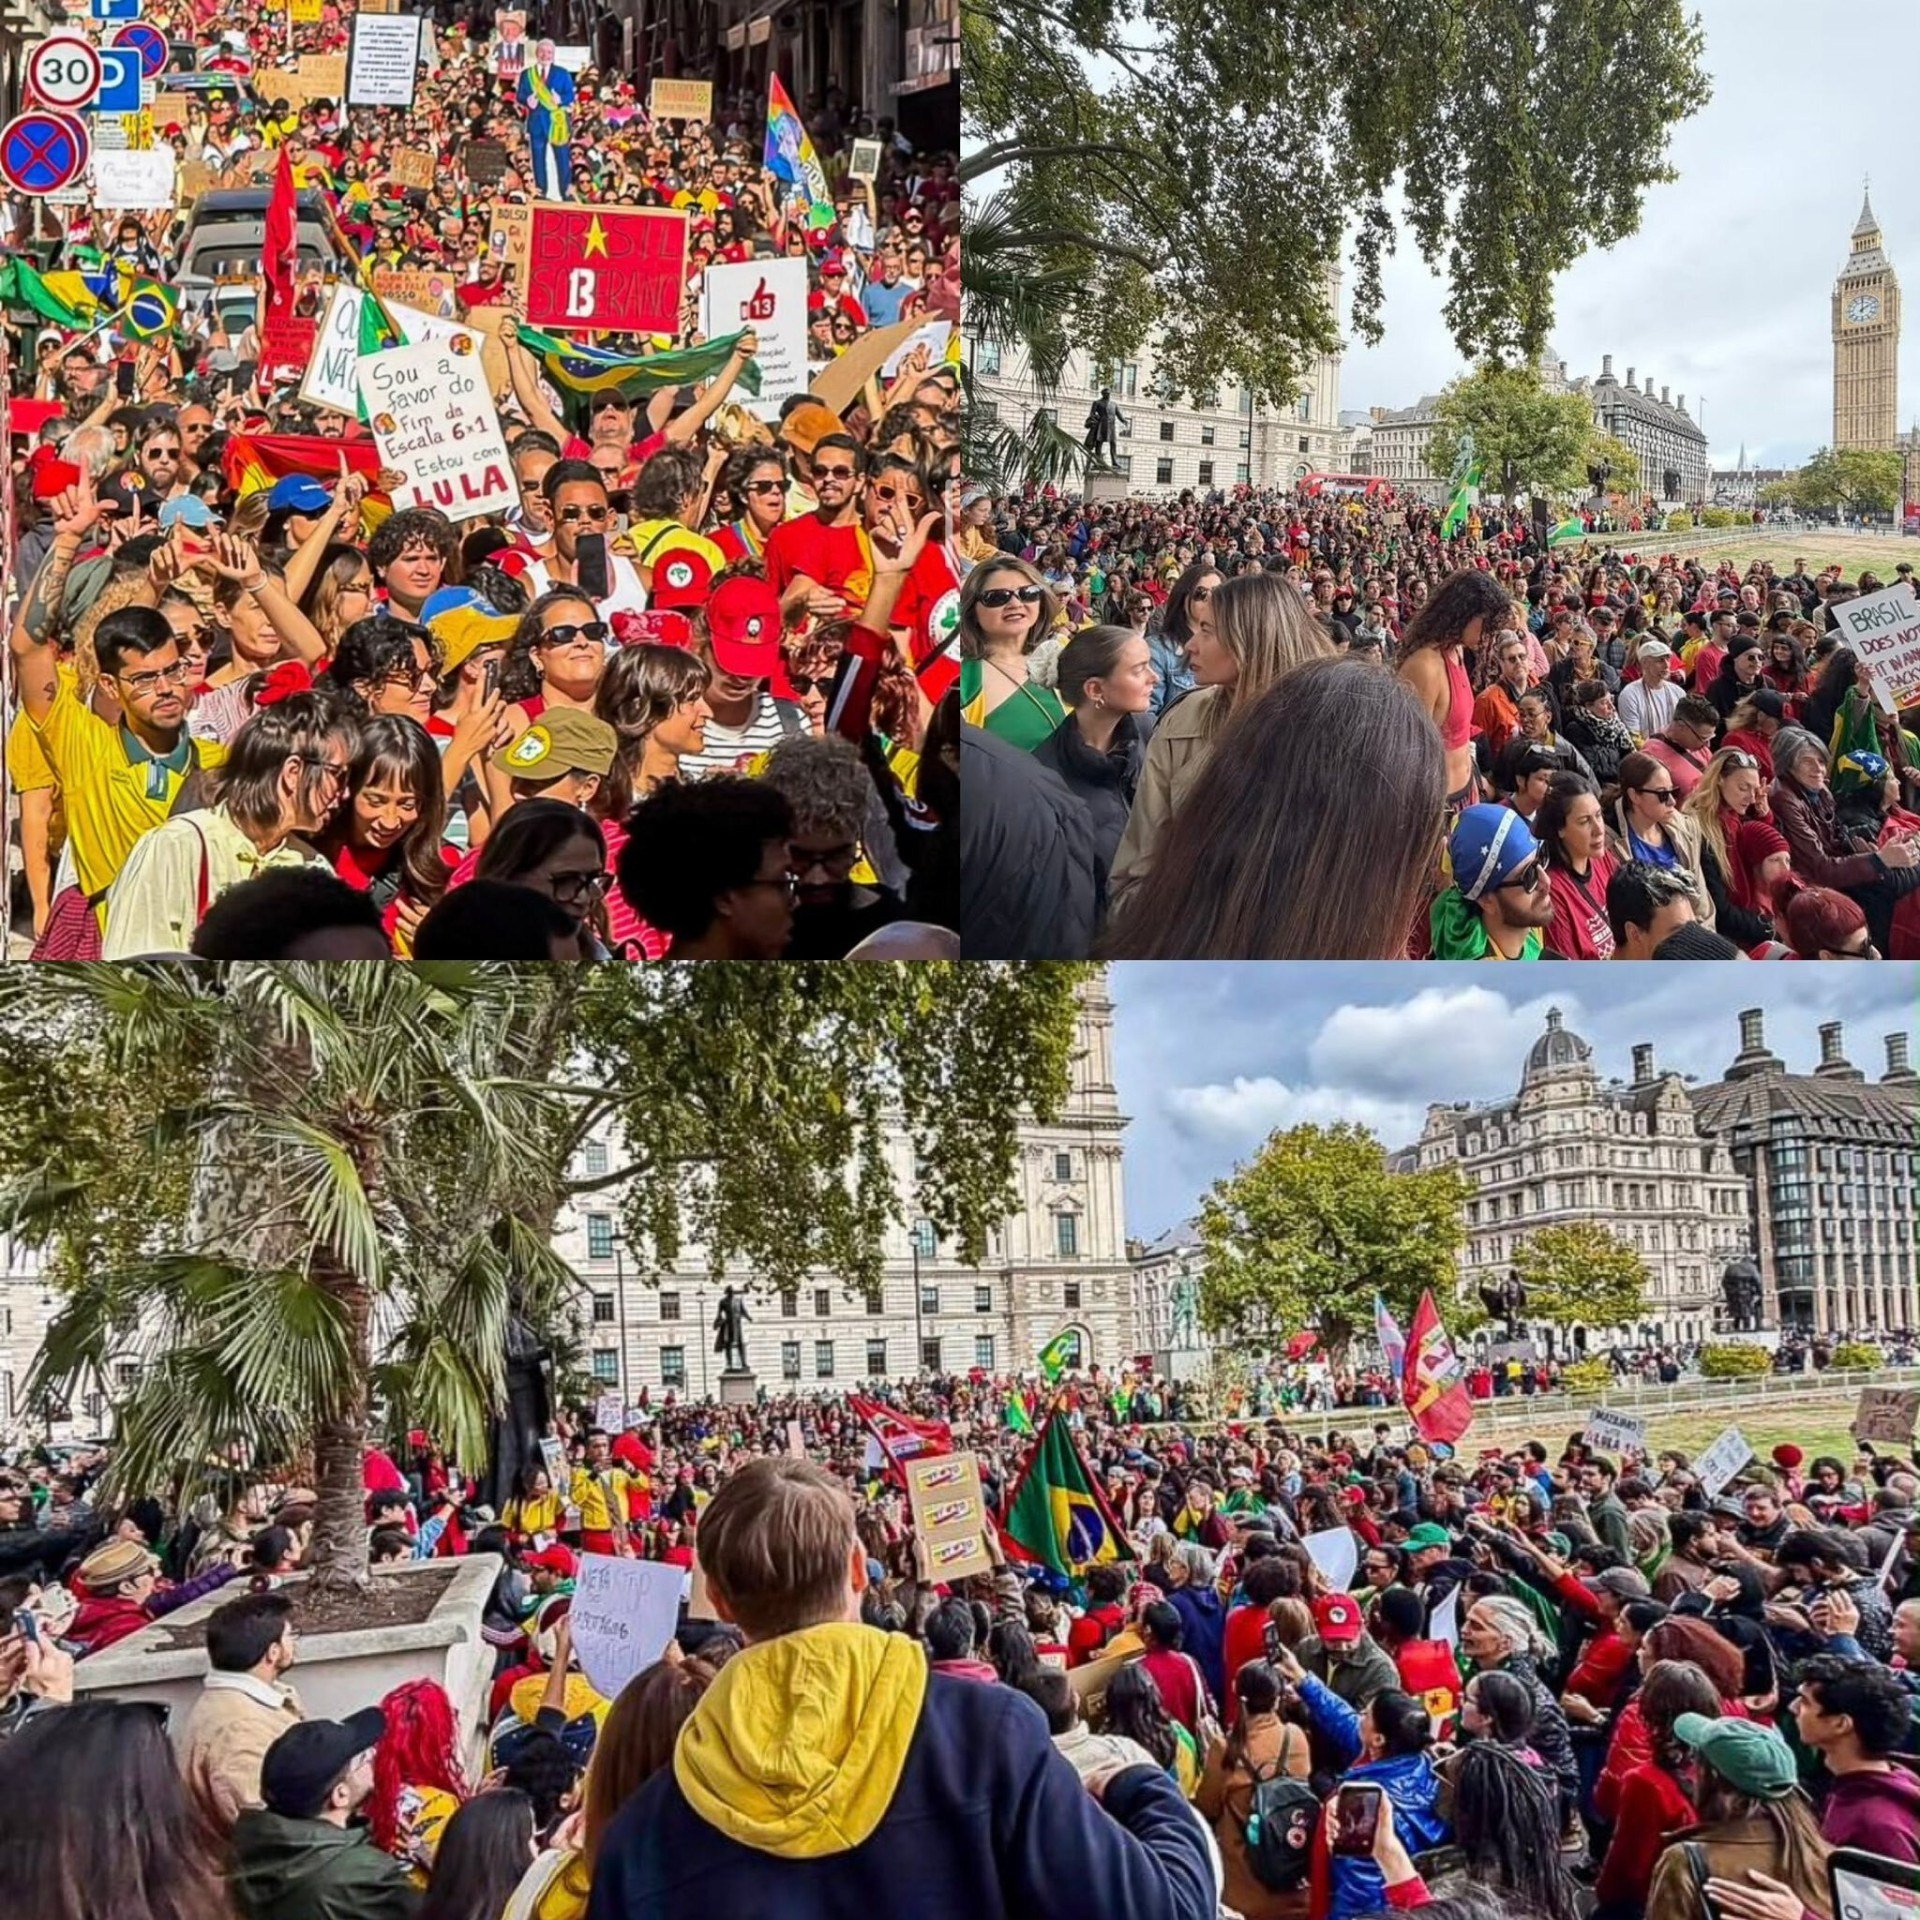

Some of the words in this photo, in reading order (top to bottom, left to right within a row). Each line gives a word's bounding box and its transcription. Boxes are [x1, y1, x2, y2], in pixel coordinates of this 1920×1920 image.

[42, 58, 89, 86] 30
[93, 56, 126, 105] P
[531, 265, 681, 321] SOBERANO
[752, 298, 773, 316] 13
[373, 362, 419, 391] Sou
[437, 358, 456, 376] a
[387, 384, 438, 415] favor
[449, 374, 475, 396] do
[399, 414, 433, 434] Fim
[444, 401, 464, 421] da
[384, 426, 445, 460] Escala
[414, 454, 464, 478] Estou
[472, 445, 502, 462] com
[412, 464, 509, 509] LULA
[1848, 599, 1914, 633] BRASIL
[1859, 634, 1895, 655] DOES
